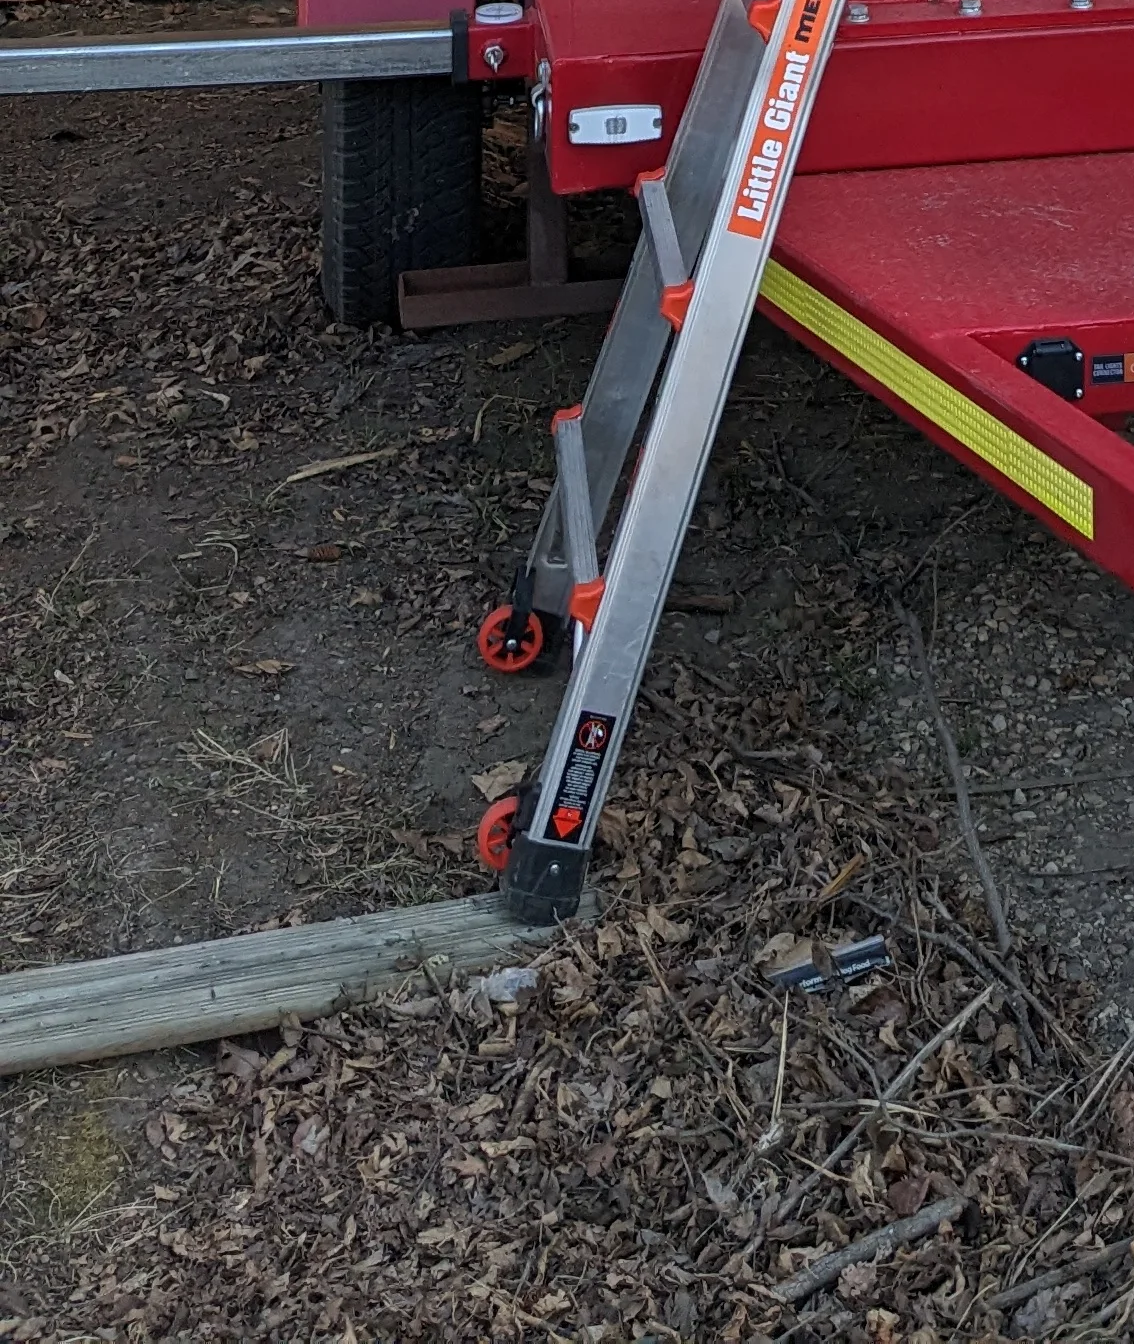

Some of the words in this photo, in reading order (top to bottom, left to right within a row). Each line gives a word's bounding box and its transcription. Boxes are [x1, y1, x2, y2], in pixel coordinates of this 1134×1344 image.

[736, 138, 783, 222] Little
[763, 50, 810, 131] Giant
[852, 958, 871, 972] Food
